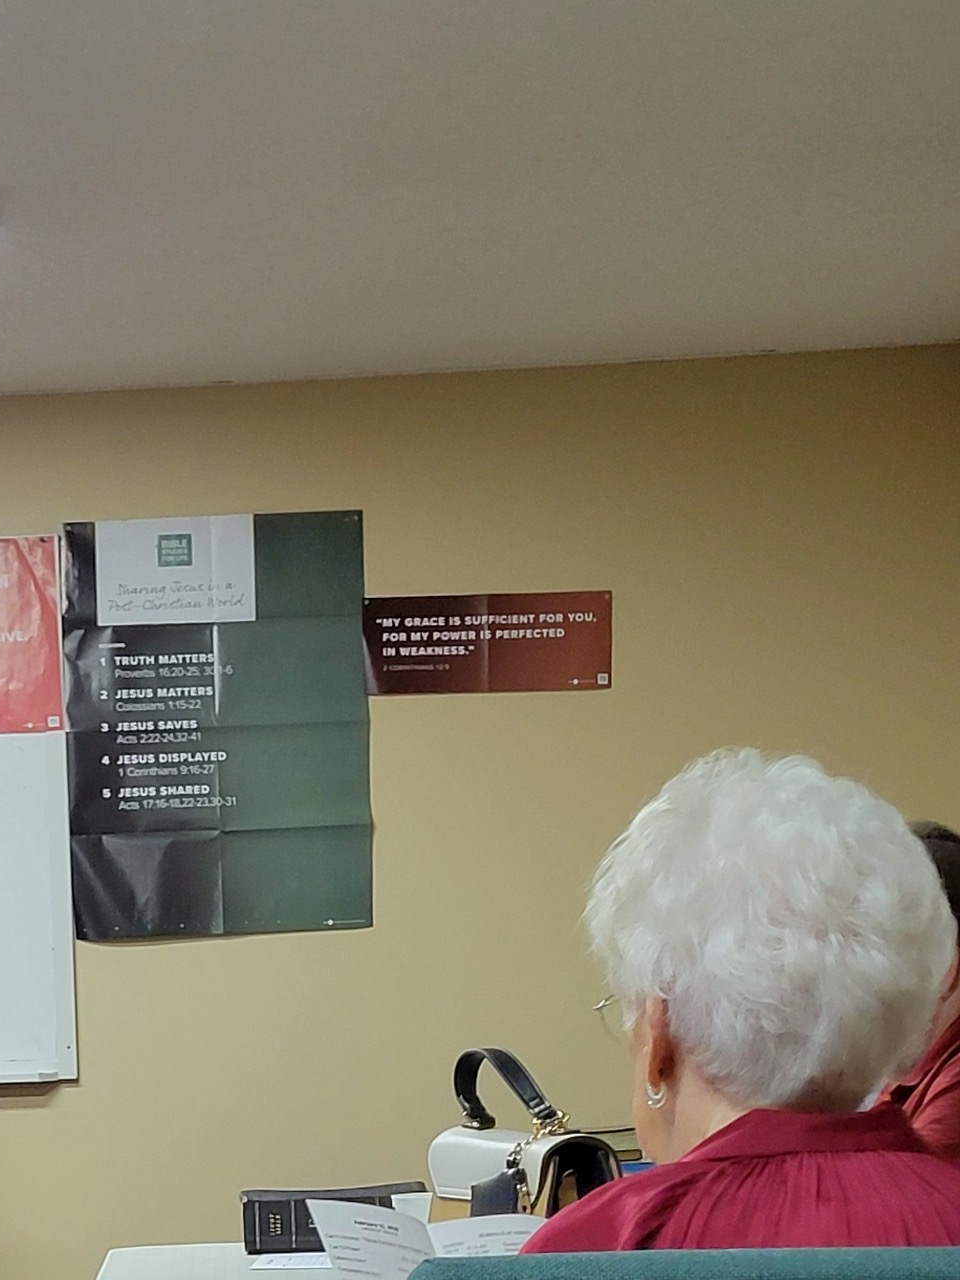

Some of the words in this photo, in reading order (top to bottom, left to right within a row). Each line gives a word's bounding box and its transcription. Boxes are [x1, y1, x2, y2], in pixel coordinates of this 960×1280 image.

[169, 581, 204, 594] Jesus
[376, 618, 401, 627] "MY
[404, 617, 445, 627] GRACE
[449, 616, 461, 626] IS
[464, 614, 535, 625] SUFFICIENT
[539, 613, 563, 623] FOR
[382, 632, 407, 642] FOR
[410, 632, 429, 641] MY
[433, 630, 476, 641] POWER
[480, 630, 492, 639] IS
[496, 628, 565, 639] PERFECTED
[382, 647, 396, 656] IN
[99, 657, 107, 666] 1
[114, 655, 155, 666] TRUTH
[158, 653, 215, 665] MATTERS
[114, 669, 156, 678] Proverbs
[99, 690, 109, 700] 2
[115, 688, 153, 699] JESUS
[157, 686, 214, 698] MATTERS
[115, 702, 165, 712] Colossians
[100, 723, 109, 732] 3
[116, 720, 155, 732] JESUS
[157, 720, 198, 730] SAVES
[116, 735, 138, 744] Acts
[101, 755, 110, 765] 4
[116, 754, 156, 765] JESUS
[158, 751, 227, 763] DISPLAYED
[118, 768, 124, 777] 1
[126, 766, 178, 777] Corinthians
[102, 788, 111, 798] 5
[117, 786, 157, 798] JESUS
[159, 785, 210, 796] SHARED
[118, 801, 140, 811] Acts
